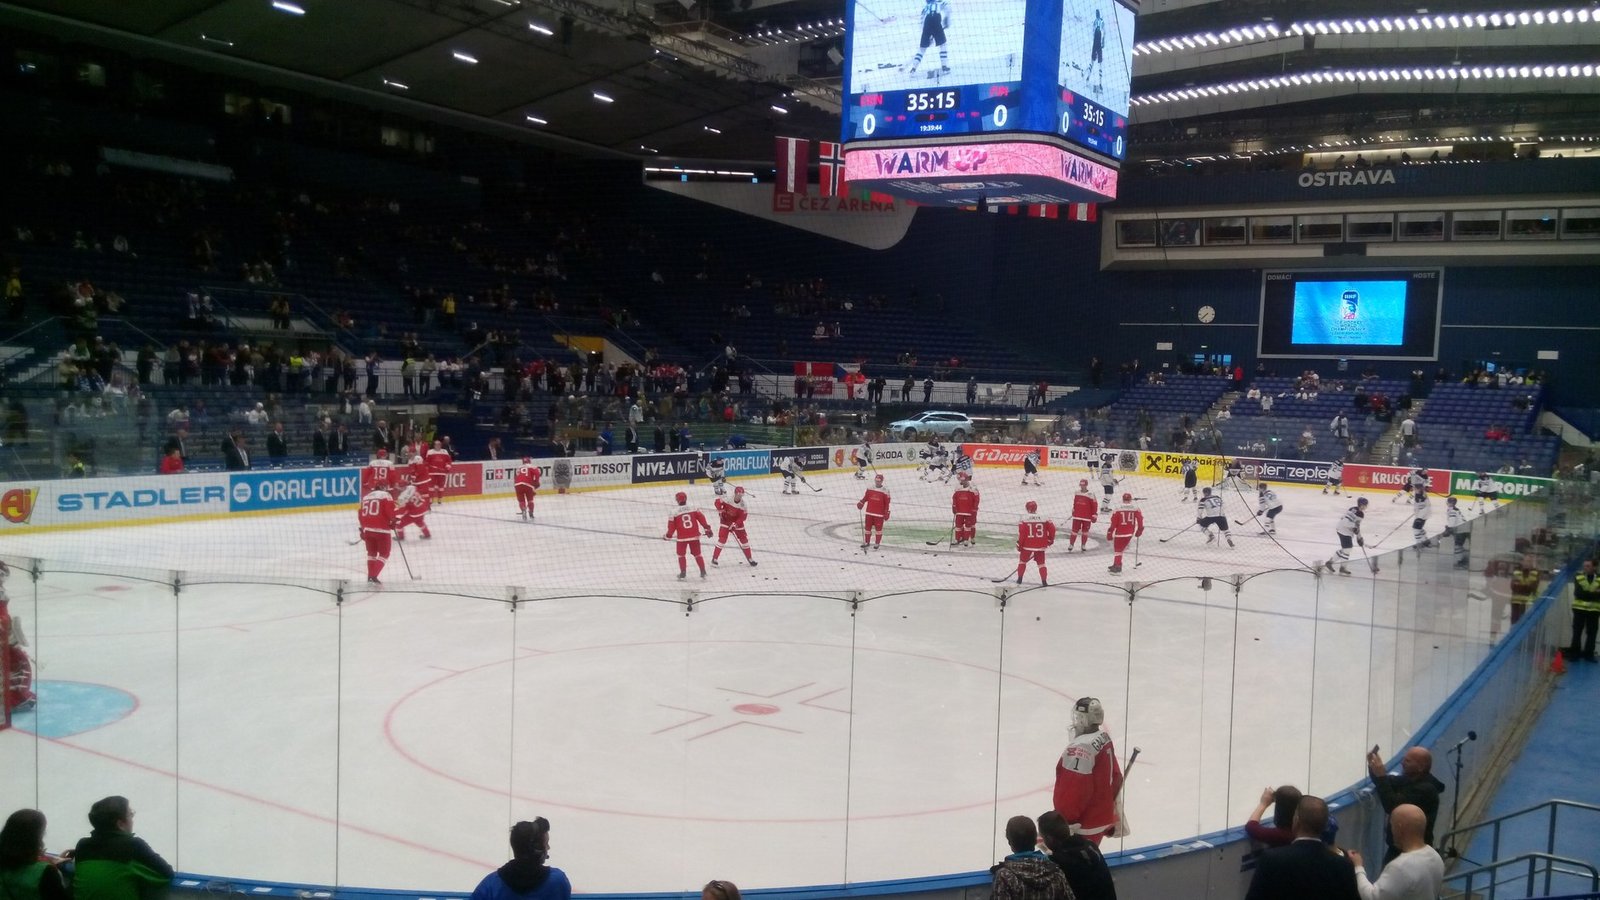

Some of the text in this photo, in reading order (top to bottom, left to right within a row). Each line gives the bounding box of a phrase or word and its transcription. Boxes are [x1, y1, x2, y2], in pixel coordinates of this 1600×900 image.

[907, 92, 955, 111] 35:15
[863, 113, 876, 135] 0
[993, 104, 1008, 127] 0
[1062, 111, 1069, 134] 0
[1083, 103, 1104, 126] 35:15
[1116, 135, 1123, 155] 0
[875, 150, 949, 175] WARM
[1060, 153, 1093, 184] WARM
[1298, 169, 1396, 188] OSTRAVA
[836, 199, 896, 212] ARENA
[590, 462, 631, 475] TISSOT
[637, 458, 705, 477] NIVEA MEN
[723, 455, 769, 472] ORALFLUX
[373, 467, 388, 480] 19
[258, 476, 358, 501] ORALFLUX
[57, 485, 226, 512] STADLER
[361, 499, 380, 516] 50
[681, 513, 693, 529] 8
[1120, 511, 1135, 526] 14
[1026, 522, 1045, 539] 13
[1073, 757, 1080, 771] 1
